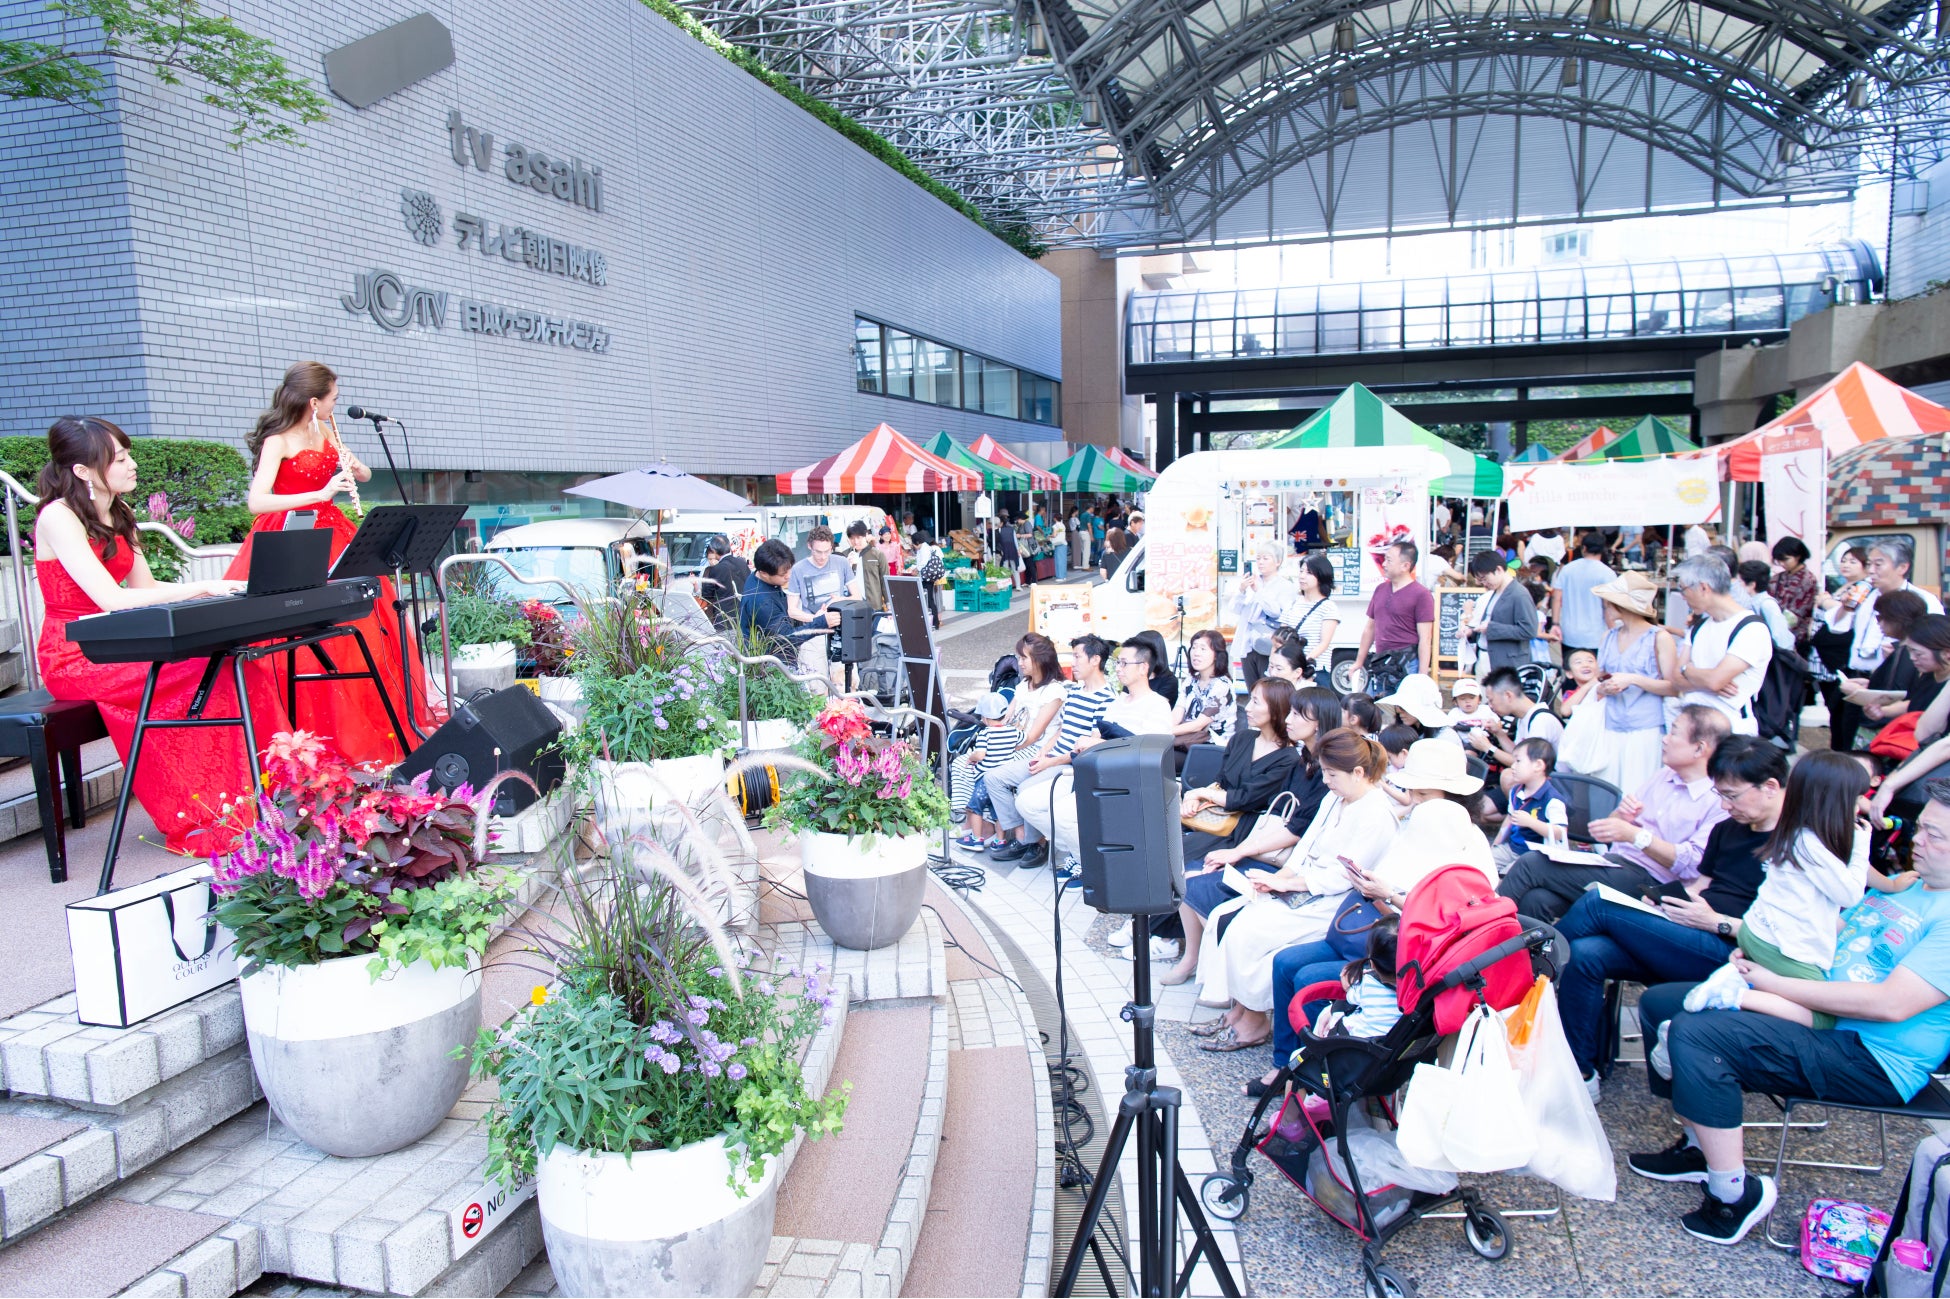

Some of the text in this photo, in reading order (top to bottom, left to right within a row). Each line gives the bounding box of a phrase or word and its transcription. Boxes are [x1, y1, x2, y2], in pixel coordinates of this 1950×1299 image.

[446, 110, 604, 213] tv asahi
[453, 211, 608, 286] テレビ朝日映像
[175, 961, 208, 981] COURT
[487, 1189, 506, 1216] NO
